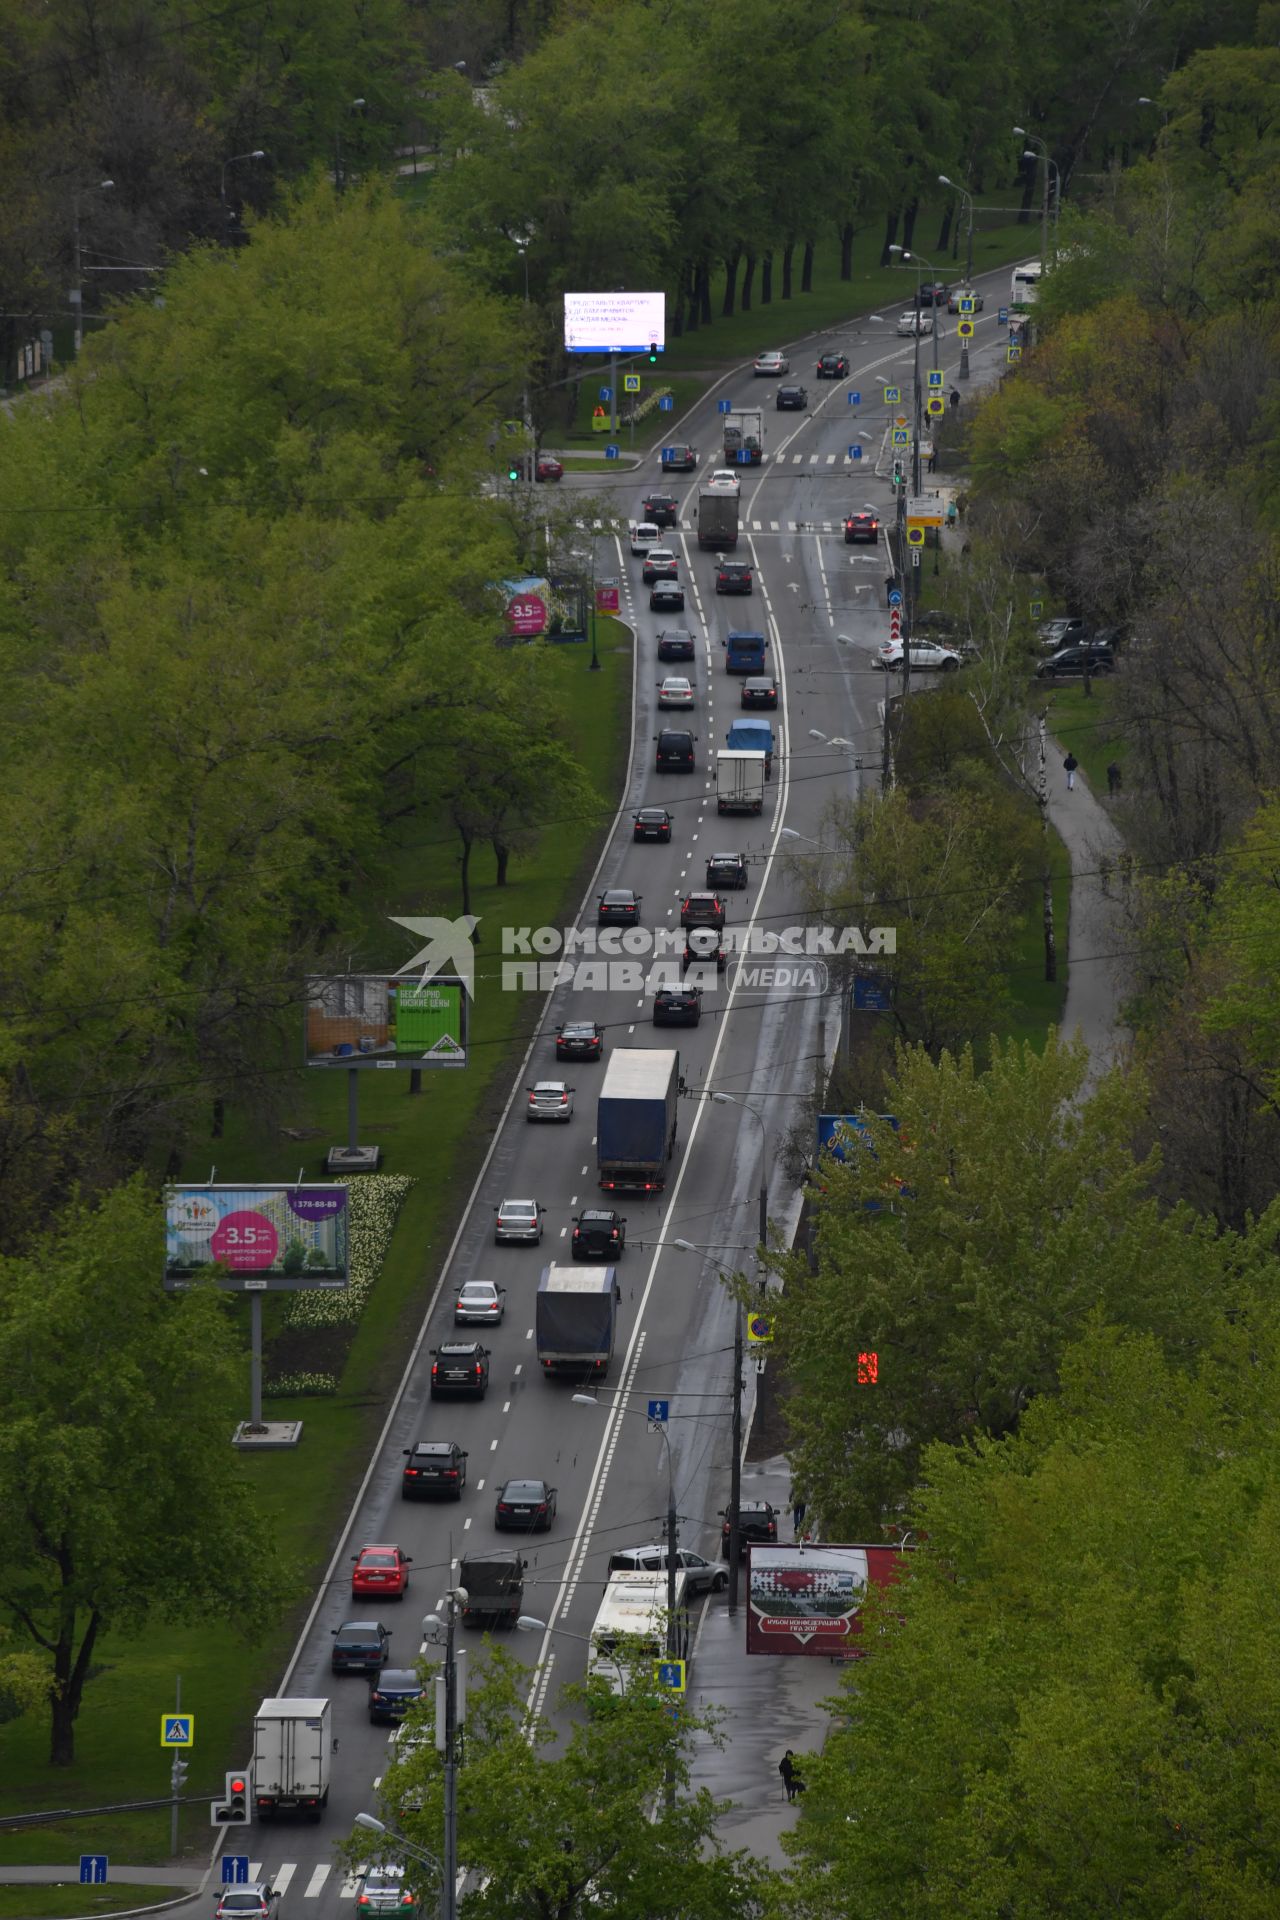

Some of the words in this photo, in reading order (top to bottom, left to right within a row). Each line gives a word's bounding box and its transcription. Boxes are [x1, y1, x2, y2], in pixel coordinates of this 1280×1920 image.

[514, 605, 533, 617] 3.5
[400, 999, 429, 1007] НИЗКИЕ
[430, 999, 450, 1008] ЦЕНЫ
[226, 1227, 257, 1244] 3.5
[789, 1619, 841, 1627] КОНФЕДЕРАЦИЙ
